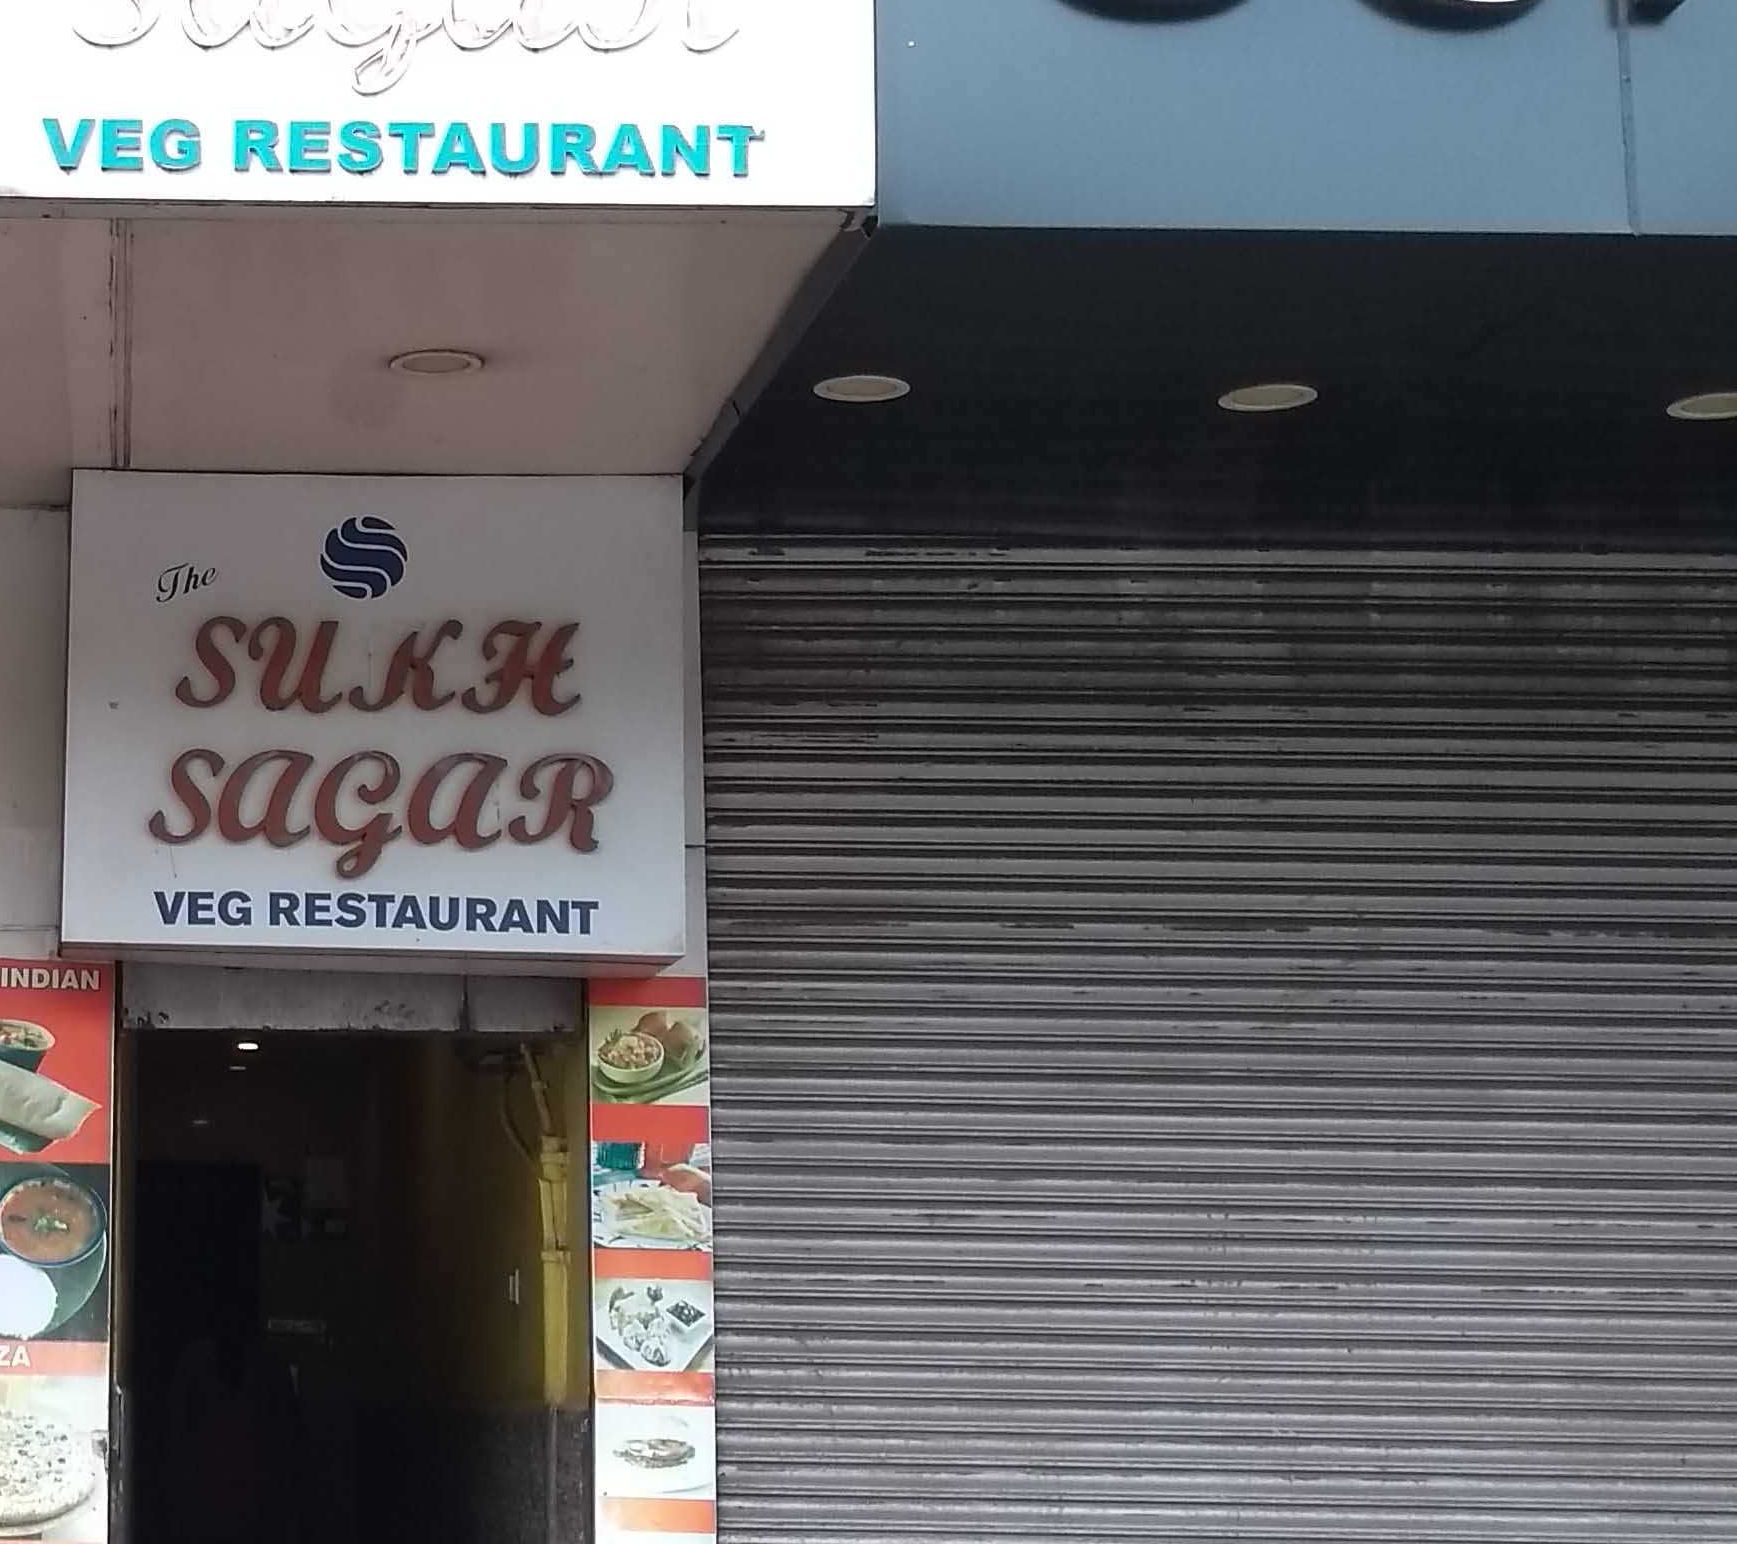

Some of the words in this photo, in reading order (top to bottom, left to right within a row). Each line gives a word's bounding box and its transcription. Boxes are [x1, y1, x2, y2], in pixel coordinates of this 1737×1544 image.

[42, 118, 203, 174] VEG
[233, 119, 766, 177] RESTAURANT
[156, 562, 219, 603] The
[174, 614, 582, 717] SUKH
[147, 747, 616, 880] SAGAR
[153, 890, 253, 928] VEG
[268, 891, 600, 936] RESTAURANT
[0, 966, 101, 991] INDIAN
